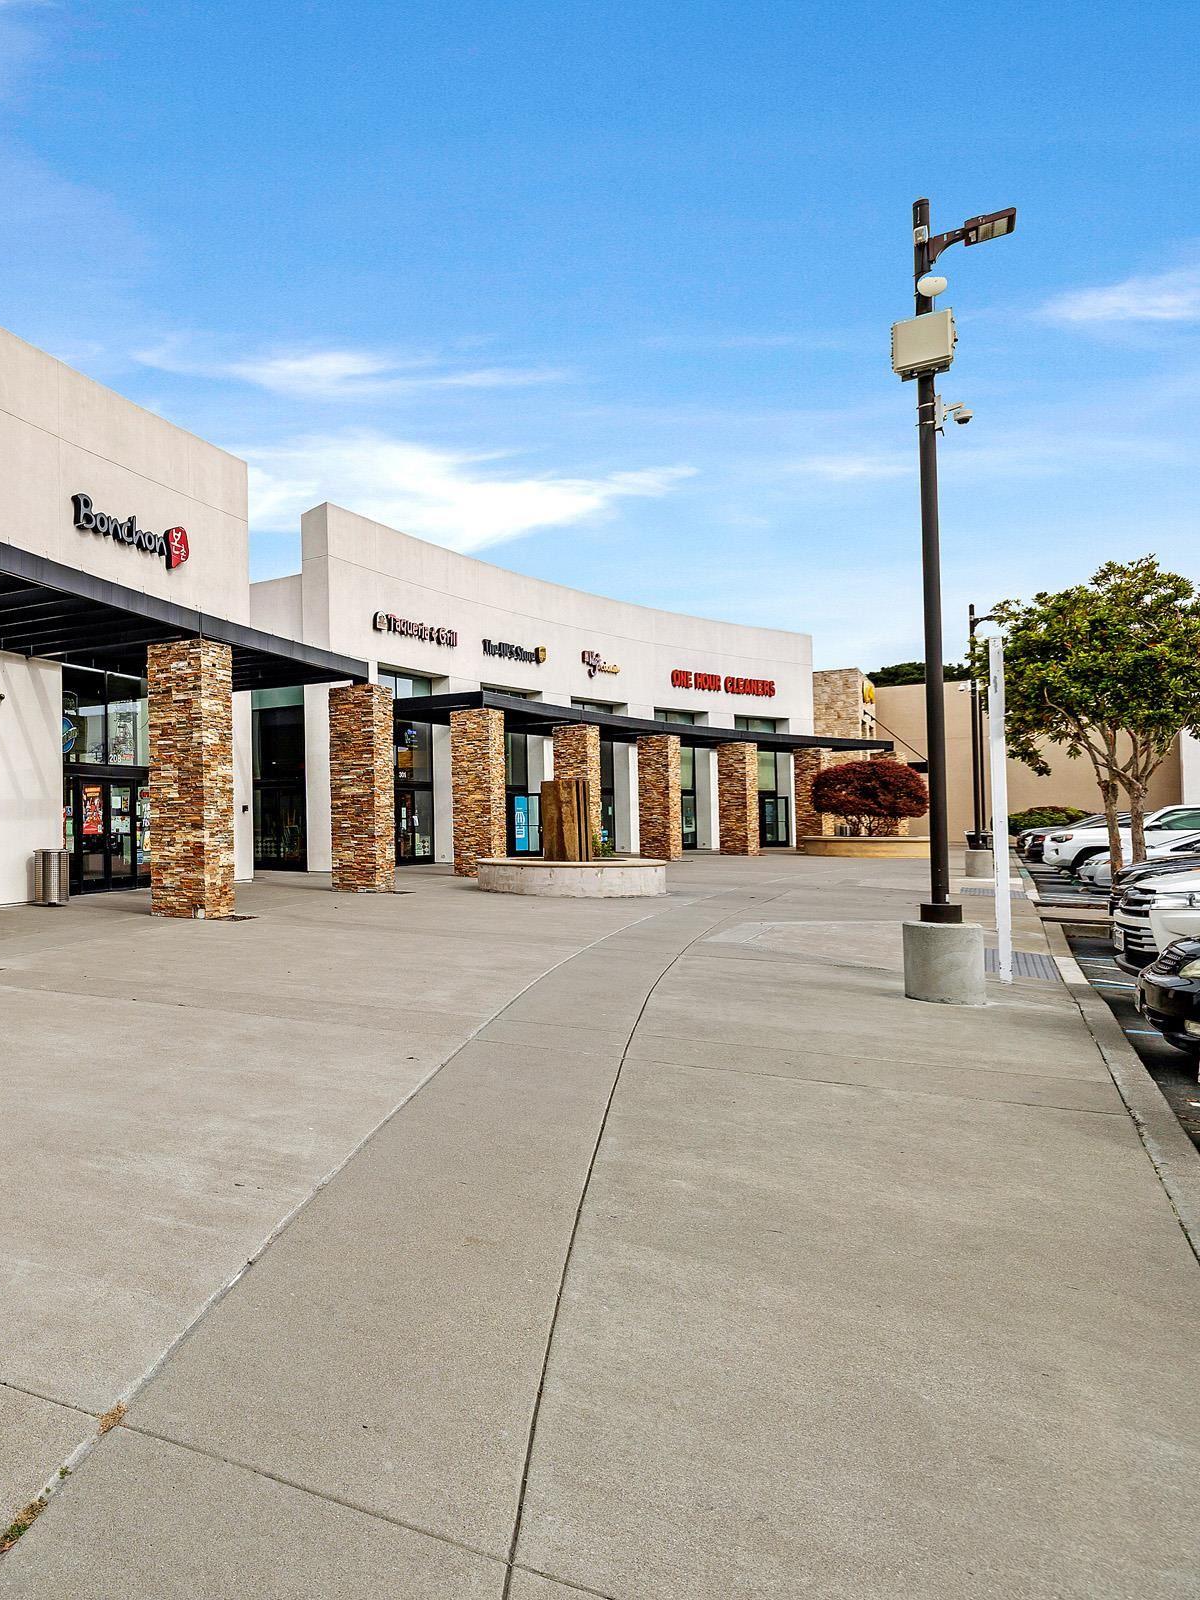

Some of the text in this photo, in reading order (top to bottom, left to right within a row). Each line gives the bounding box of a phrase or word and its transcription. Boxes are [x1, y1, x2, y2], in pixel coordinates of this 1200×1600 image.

[71, 493, 168, 557] Bonchon
[386, 613, 430, 641] Taqueria
[436, 627, 458, 647] Grill
[482, 639, 498, 656] The
[498, 642, 515, 660] UPS
[514, 646, 536, 663] Store
[671, 669, 776, 697] ONE HOUR CLEANERS
